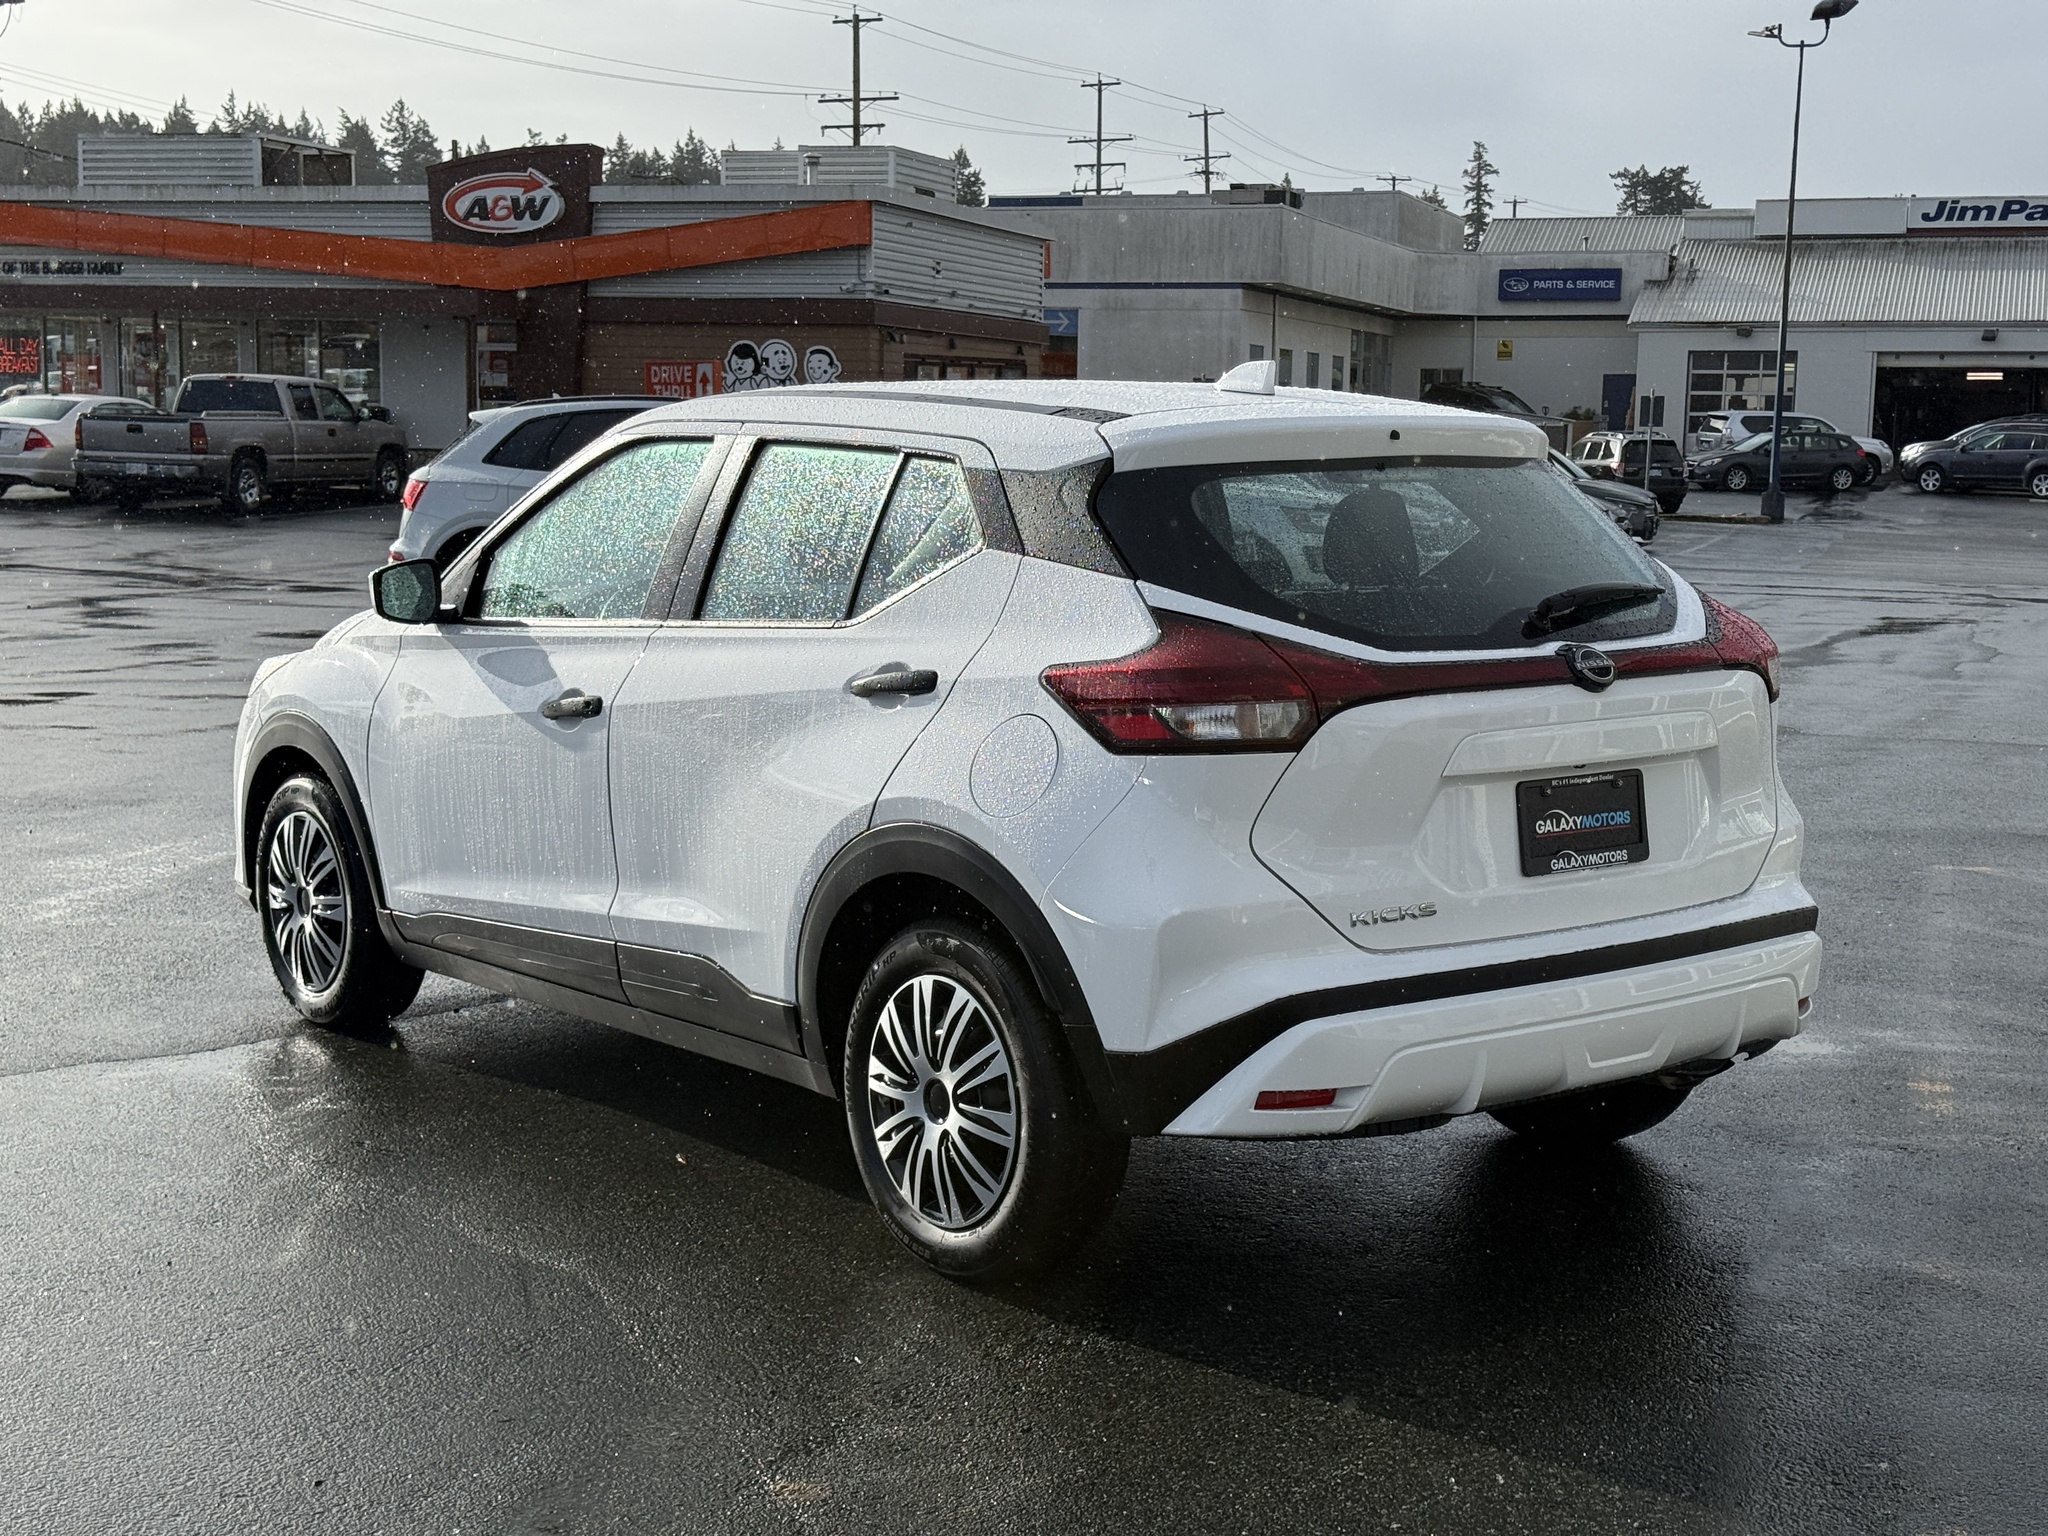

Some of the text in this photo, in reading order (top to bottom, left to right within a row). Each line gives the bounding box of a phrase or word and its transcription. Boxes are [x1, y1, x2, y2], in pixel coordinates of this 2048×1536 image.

[461, 194, 552, 222] A&W
[1921, 200, 1997, 222] Jim
[2, 261, 17, 275] OF
[1533, 280, 1616, 289] PARTS & SERVICE
[0, 337, 39, 355] ALL DAY
[651, 365, 692, 383] DRIVE
[1576, 659, 1616, 669] NISSAN
[1349, 901, 1437, 928] KICKS
[882, 950, 897, 969] HP
